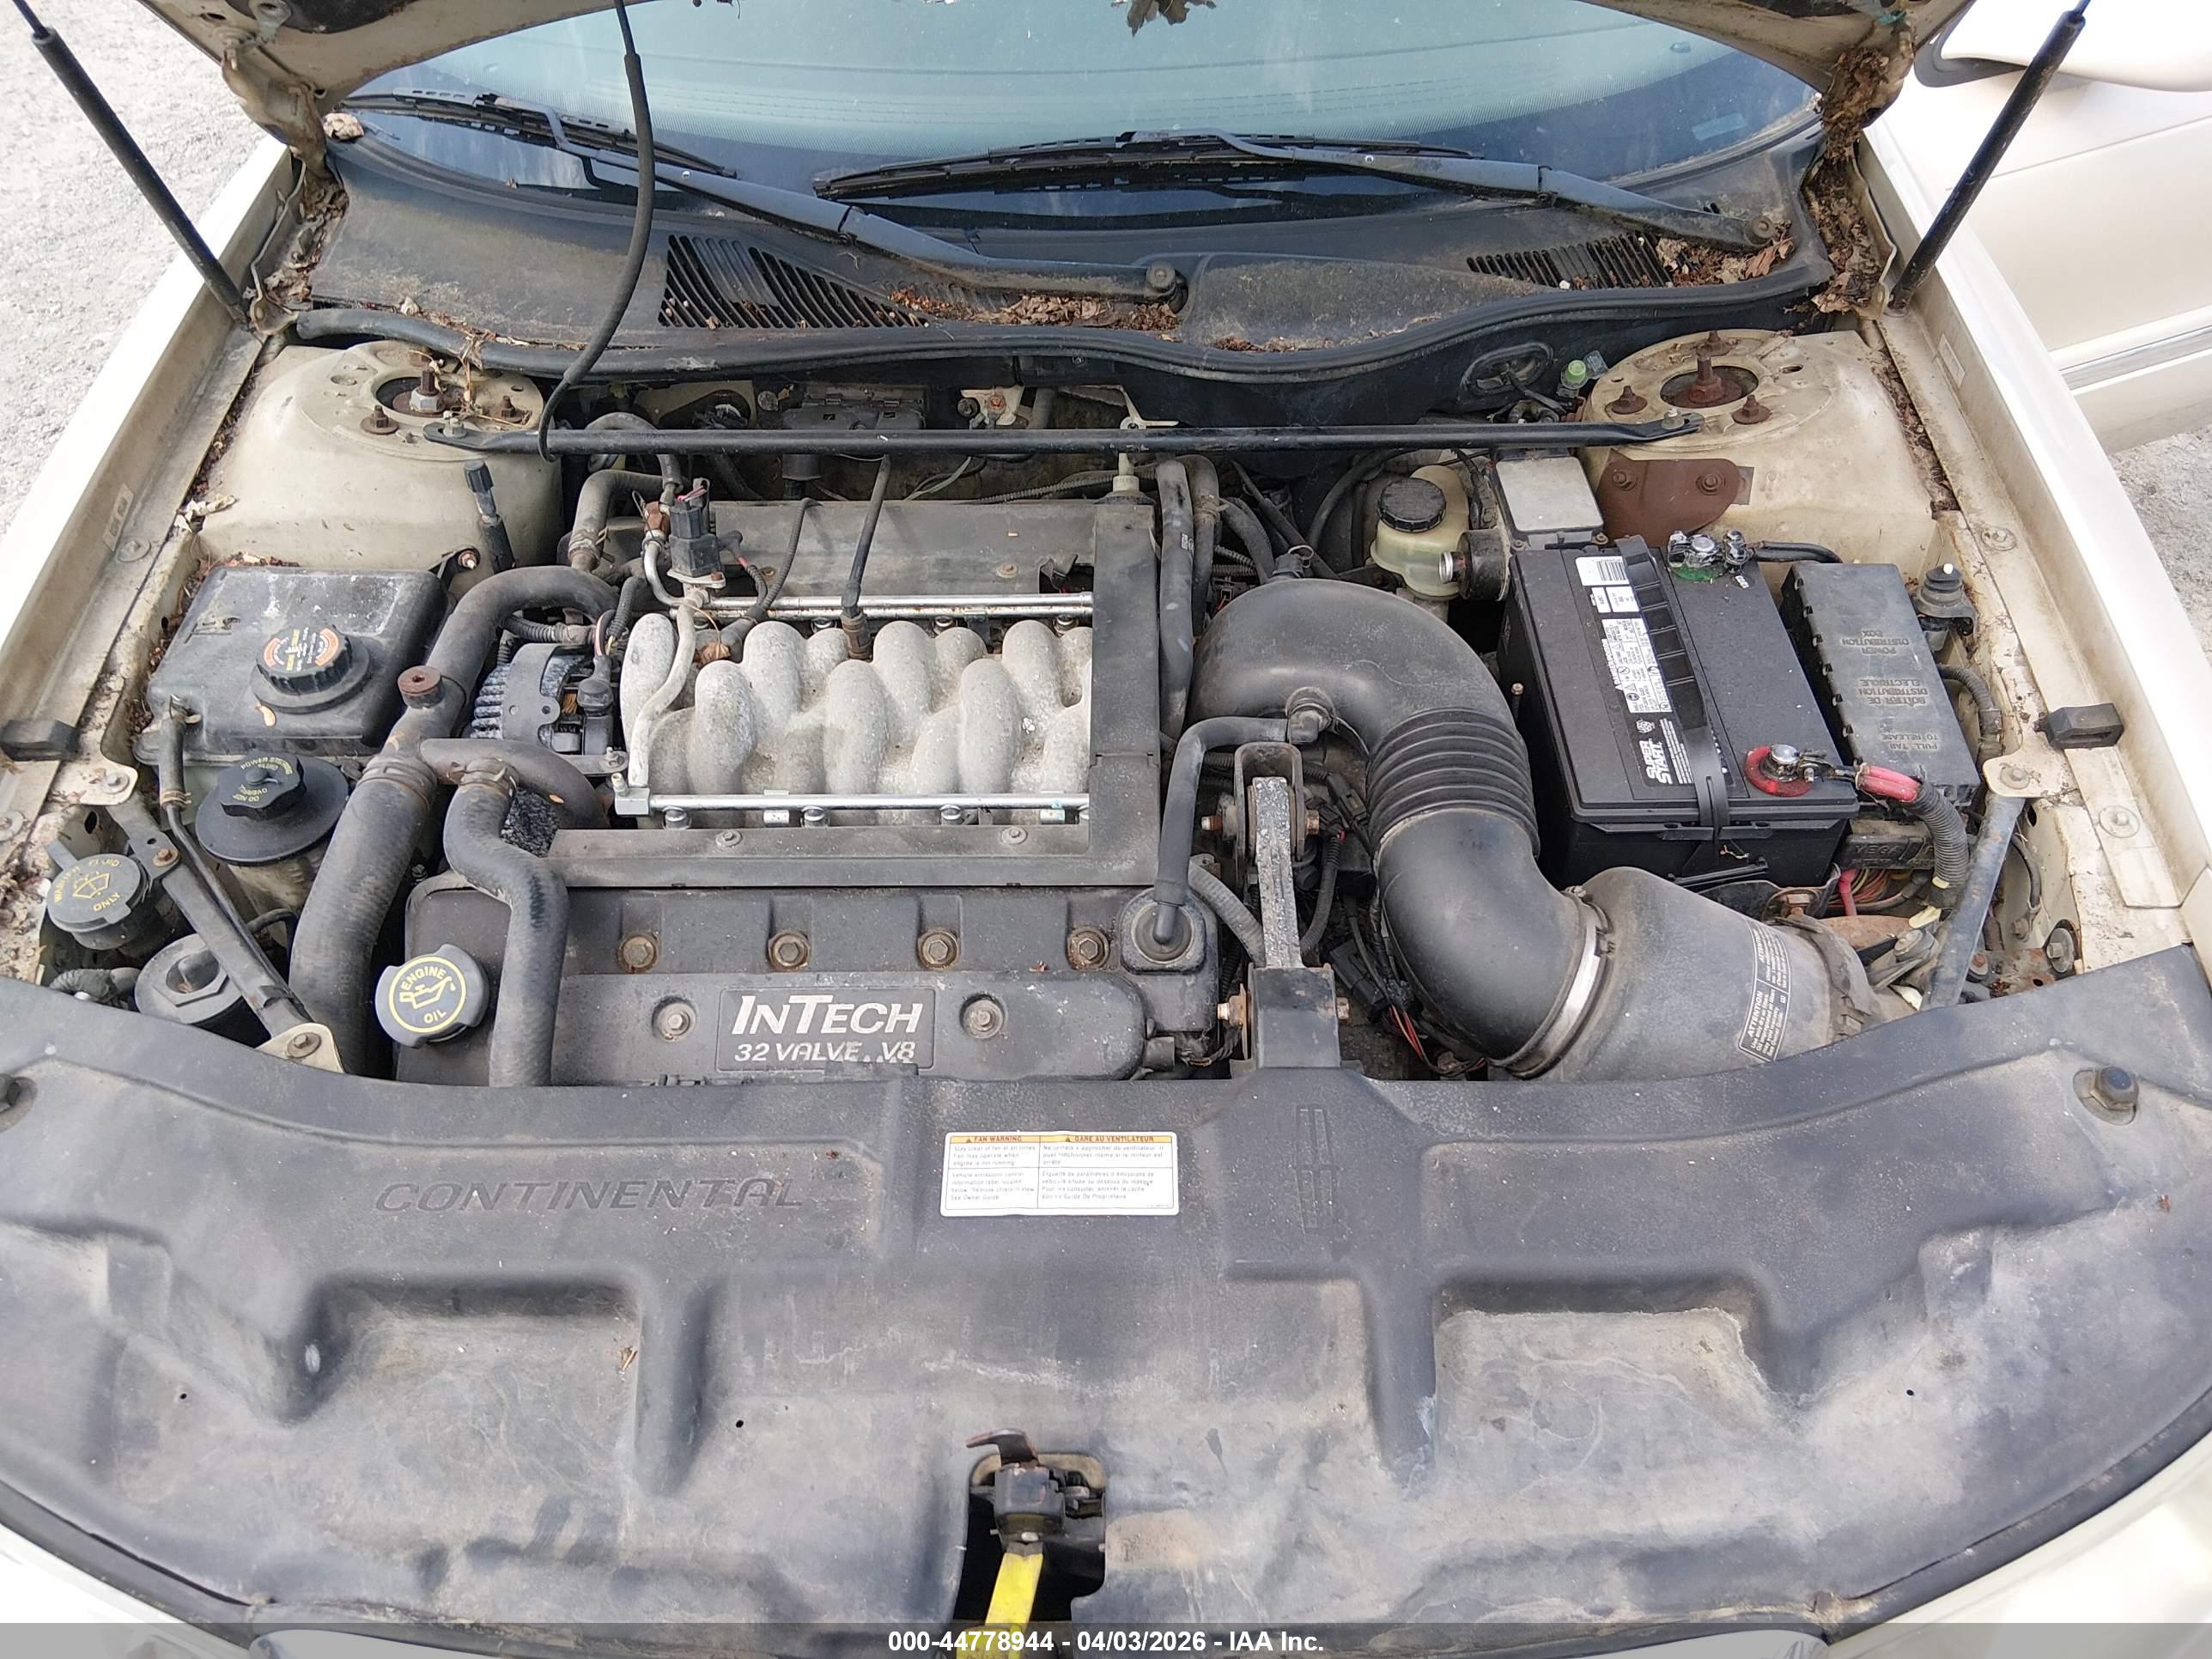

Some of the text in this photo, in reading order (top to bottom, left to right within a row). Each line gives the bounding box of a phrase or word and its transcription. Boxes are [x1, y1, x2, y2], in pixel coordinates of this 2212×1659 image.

[240, 757, 269, 769] POWER
[1639, 740, 1656, 779] SUPER
[1648, 738, 1673, 785] START
[93, 892, 121, 912] ONLY
[401, 966, 447, 990] ENGINE
[423, 1009, 447, 1024] OIL
[1747, 990, 1763, 1037] ATTENTION
[734, 1041, 916, 1062] 32 VALVE V8
[374, 1176, 804, 1212] CONTINENTAL
